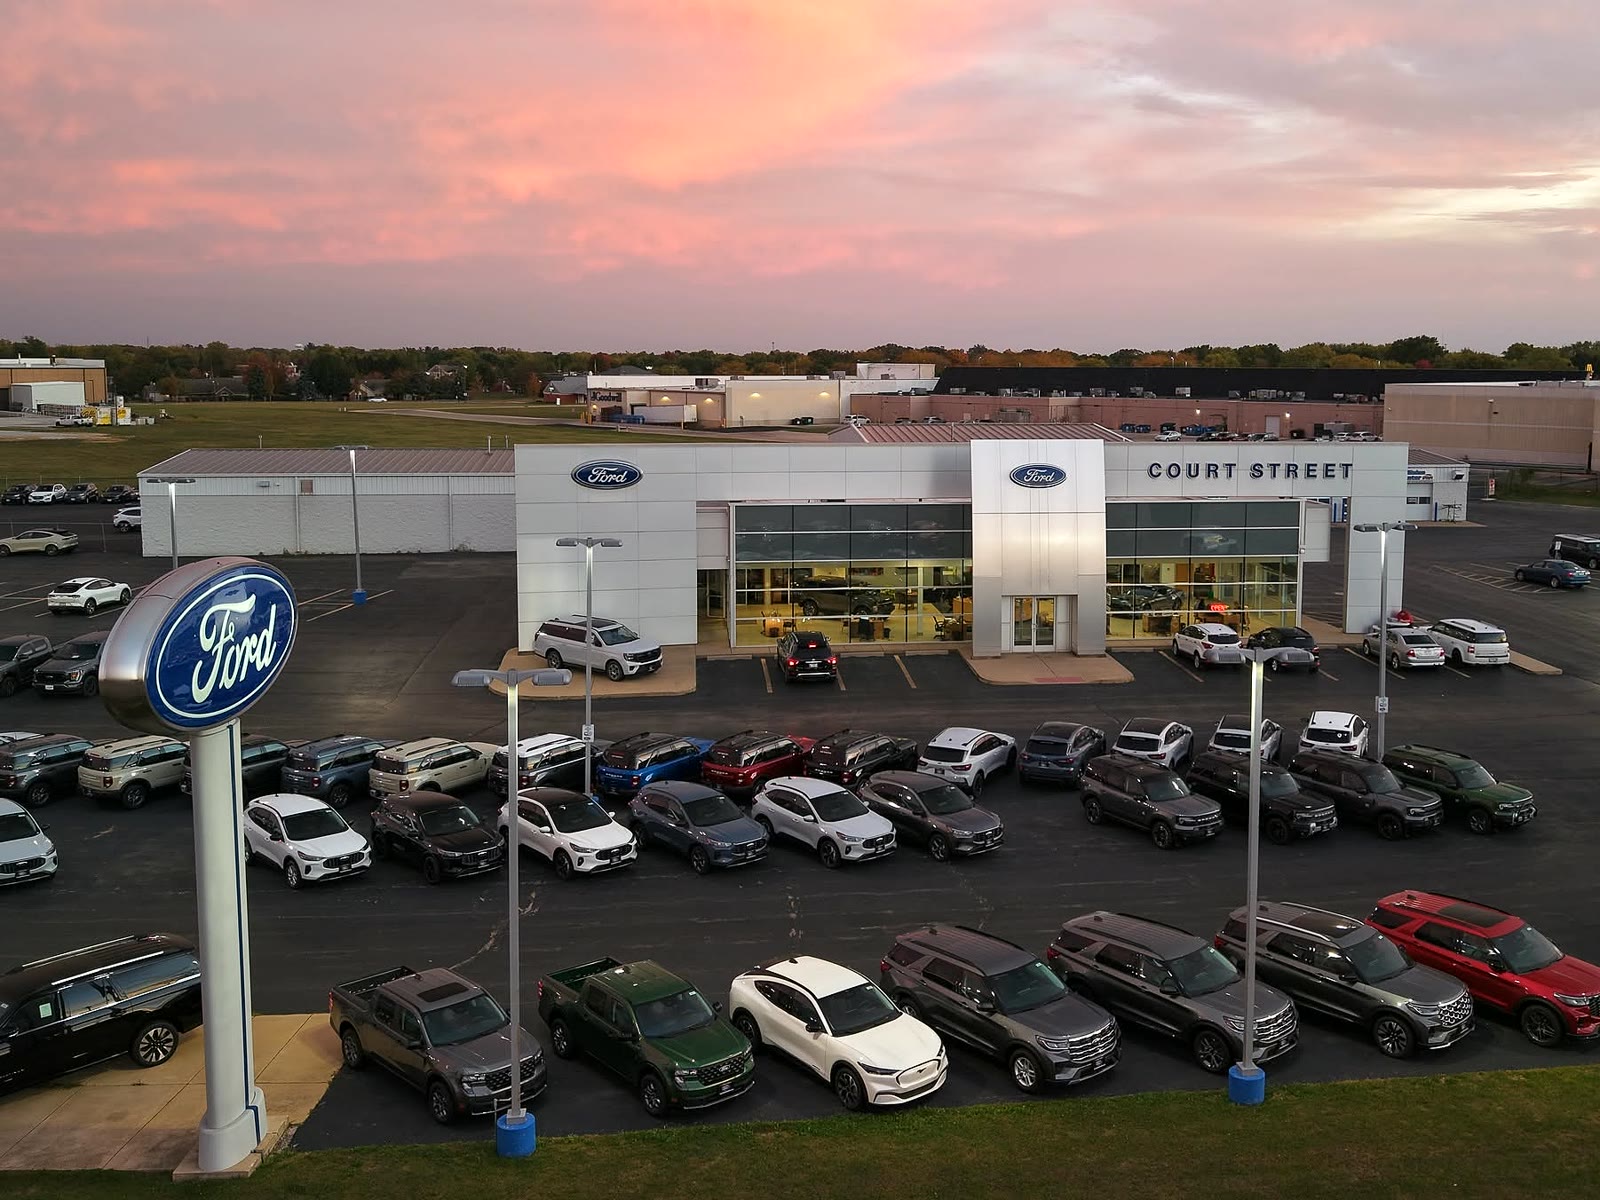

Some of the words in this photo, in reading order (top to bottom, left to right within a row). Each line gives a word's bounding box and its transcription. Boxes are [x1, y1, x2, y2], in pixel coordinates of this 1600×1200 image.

[588, 466, 627, 482] Ford
[1024, 469, 1055, 481] Ford
[1148, 463, 1236, 479] COURT
[1250, 463, 1353, 479] STREET
[192, 593, 277, 704] Ford
